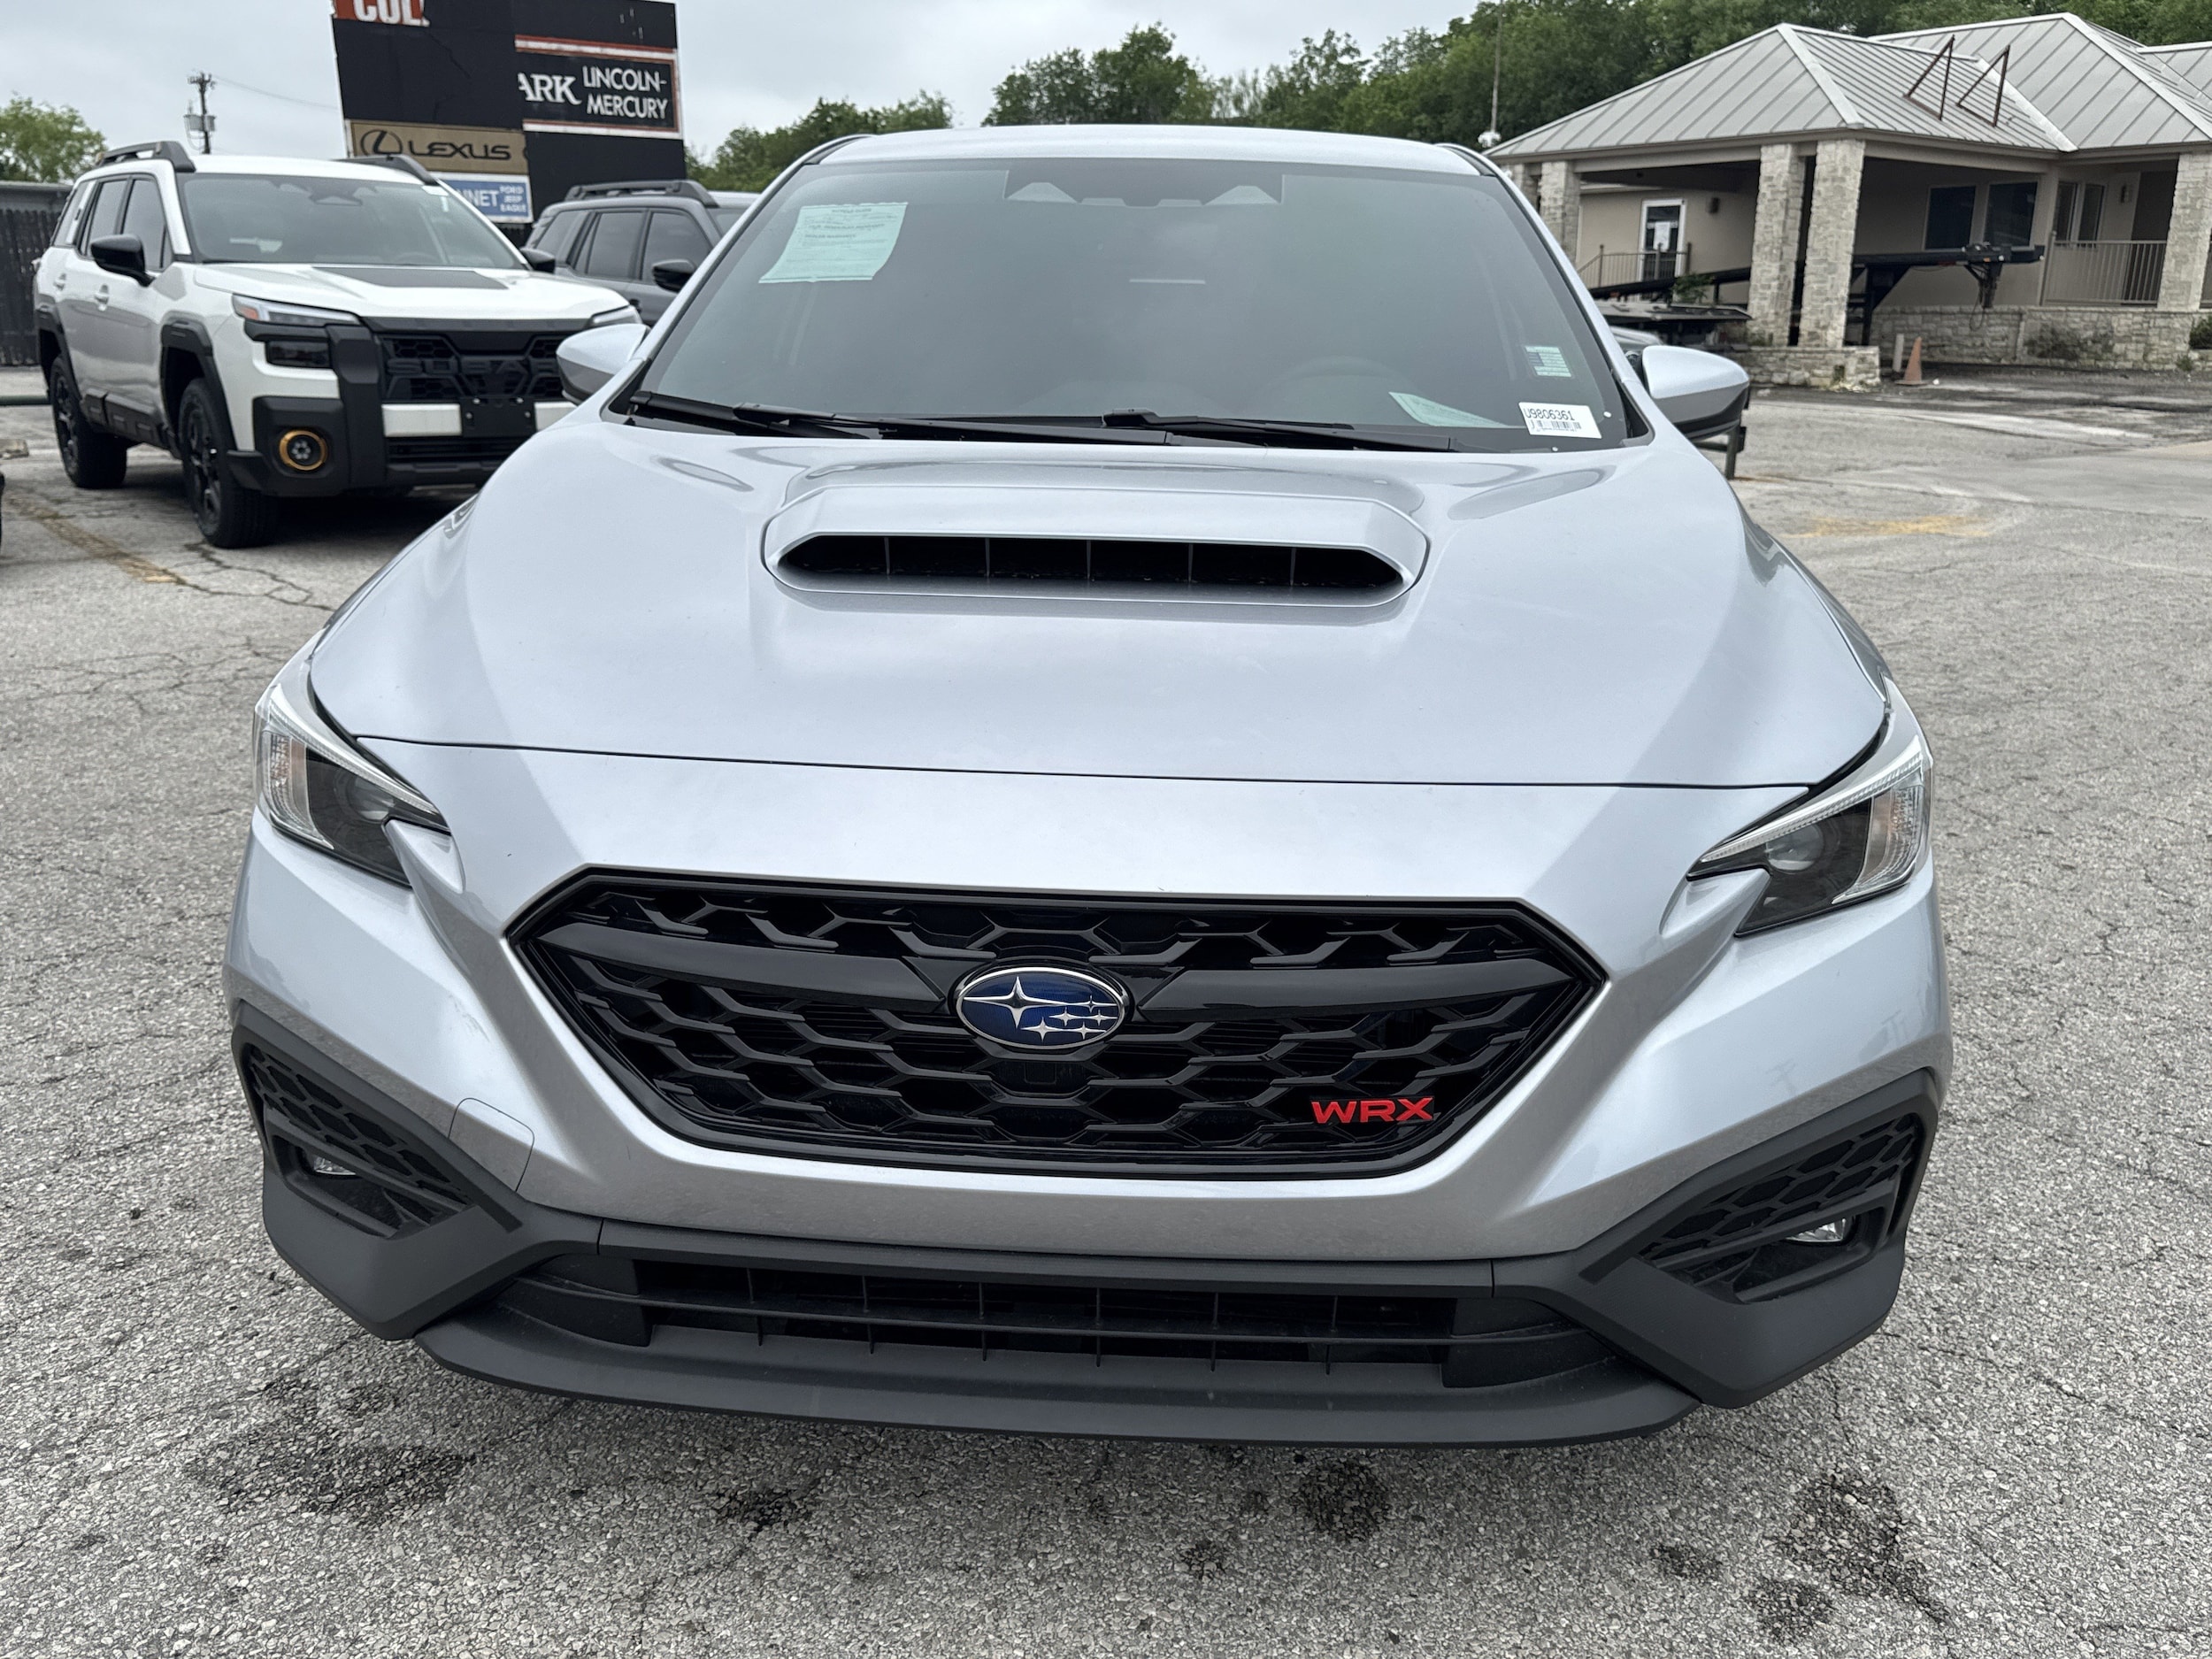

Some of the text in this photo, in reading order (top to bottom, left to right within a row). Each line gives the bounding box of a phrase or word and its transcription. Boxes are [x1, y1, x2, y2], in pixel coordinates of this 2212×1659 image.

[582, 65, 667, 92] LINCOLN-
[587, 93, 668, 119] MERCURY
[408, 140, 511, 161] LEXUS
[387, 357, 560, 374] SUBAR
[1523, 408, 1575, 421] U9806361
[1311, 1097, 1433, 1124] WRX
